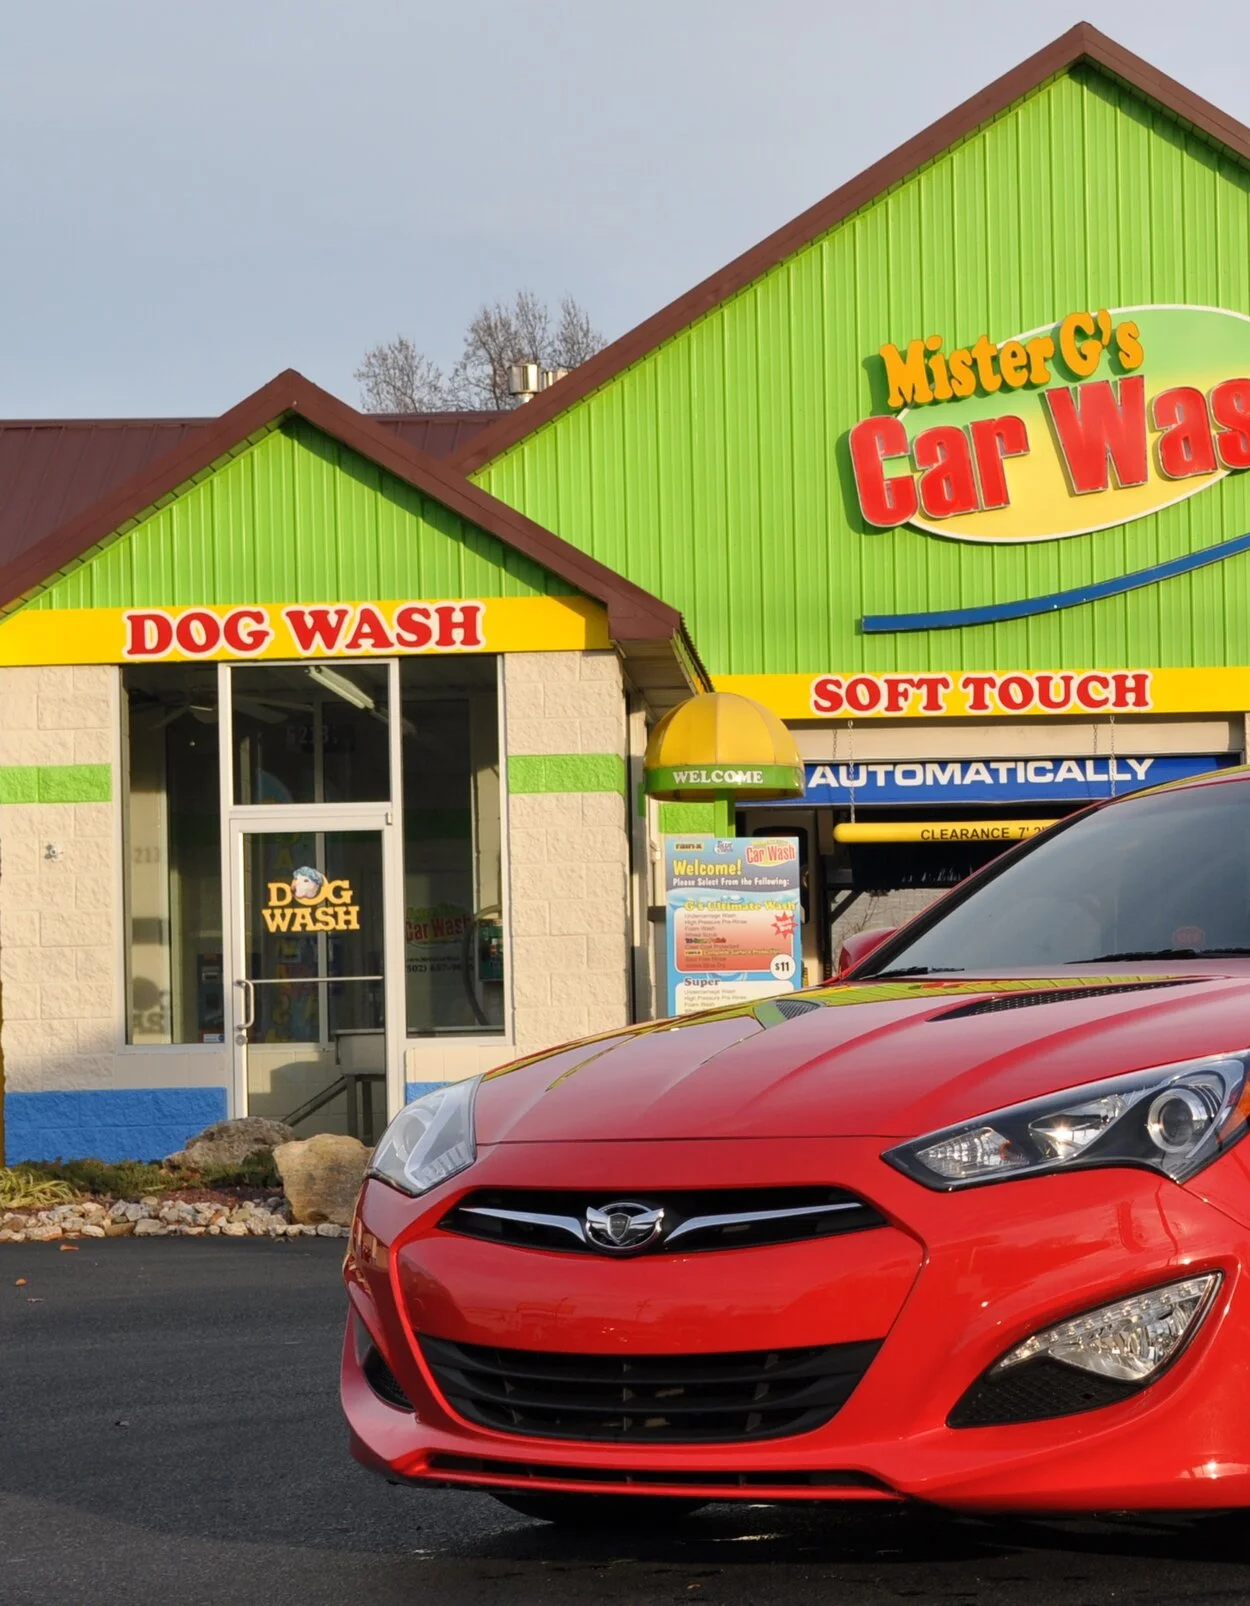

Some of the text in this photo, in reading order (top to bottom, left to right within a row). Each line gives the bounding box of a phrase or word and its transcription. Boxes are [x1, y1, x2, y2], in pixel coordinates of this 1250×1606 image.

[879, 309, 1144, 407] Mister G's
[849, 414, 1030, 528] Car
[125, 604, 482, 657] DOG WASH
[813, 673, 1151, 713] SOFT TOUCH
[672, 769, 764, 784] WELCOME
[808, 759, 1154, 788] AUTOMATICALLY
[920, 827, 1010, 841] CLEARANCE
[746, 846, 764, 863] Car
[768, 844, 795, 861] Wash
[673, 859, 742, 876] Welcome!
[267, 872, 353, 906] DOG
[673, 877, 789, 887] Please Select From the Following:
[261, 906, 360, 933] WASH
[406, 921, 428, 941] Car
[775, 962, 790, 971] $11
[684, 977, 720, 987] Super
